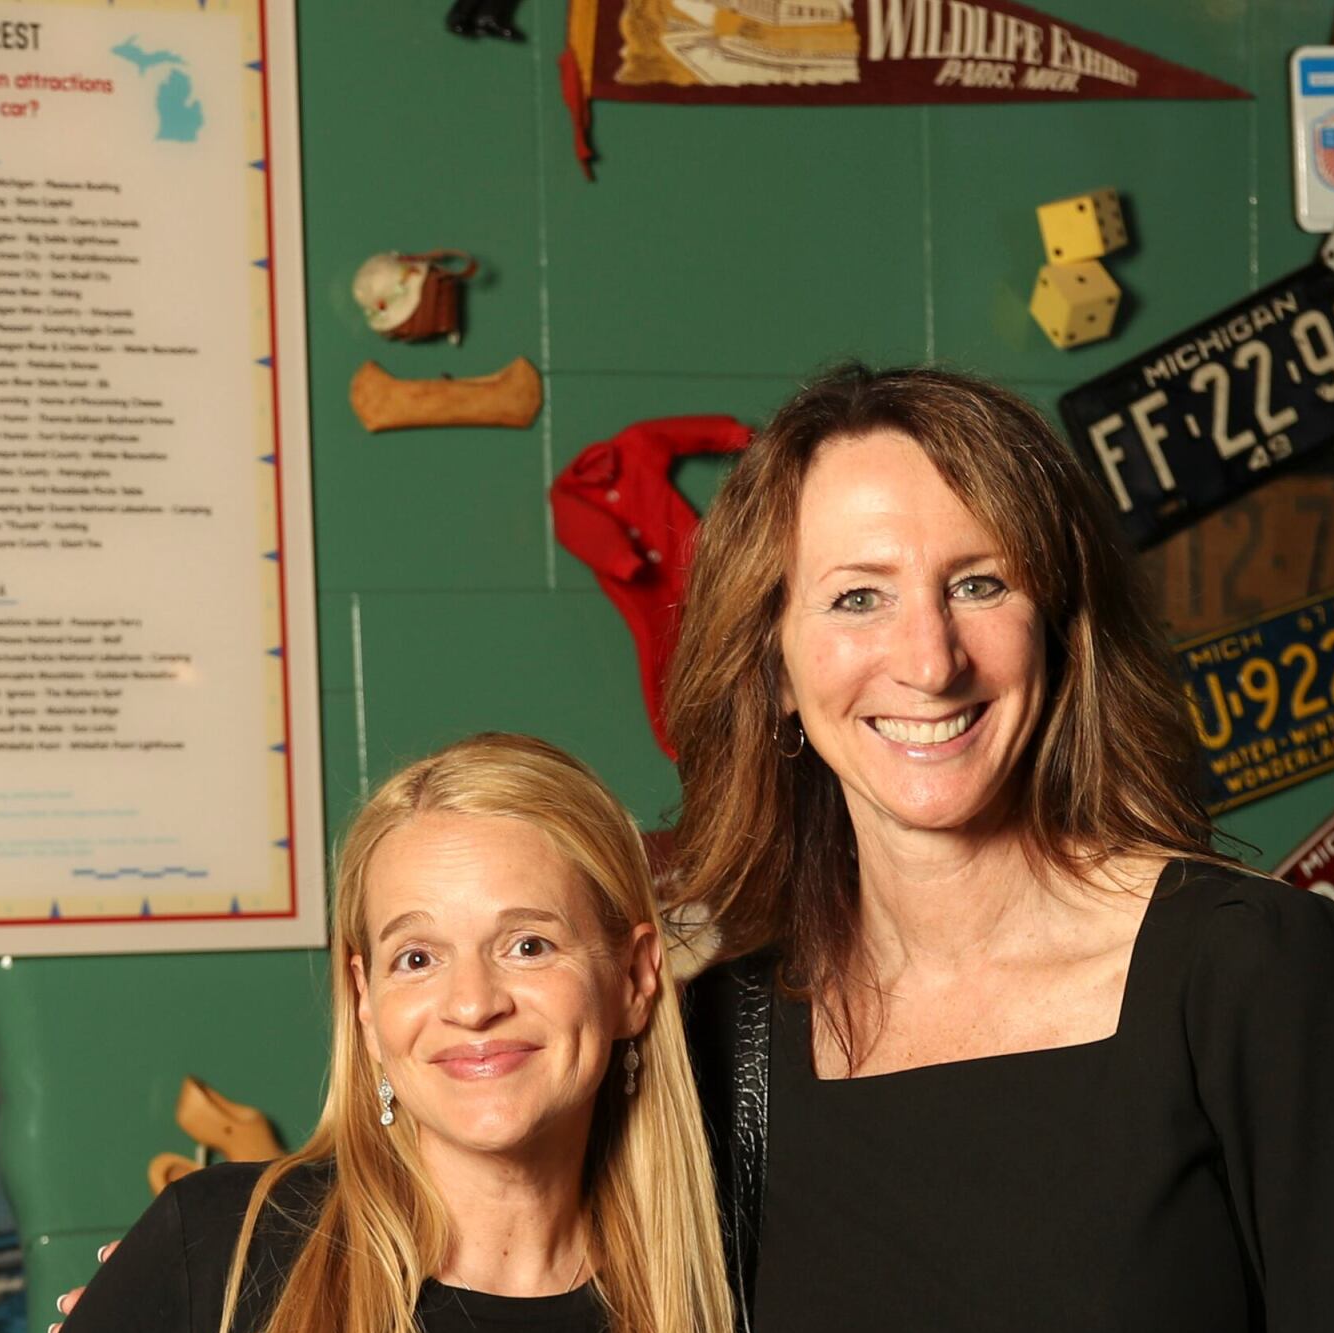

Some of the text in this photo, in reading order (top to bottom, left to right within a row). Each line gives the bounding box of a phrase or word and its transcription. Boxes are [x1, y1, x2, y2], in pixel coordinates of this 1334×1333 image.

[868, 0, 1140, 89] WILDLIFE EXHIBIT
[15, 73, 114, 95] attractions
[0, 98, 39, 119] car?
[1143, 290, 1298, 388] MICHIGAN
[1247, 437, 1294, 471] 49
[1187, 631, 1264, 671] MICH
